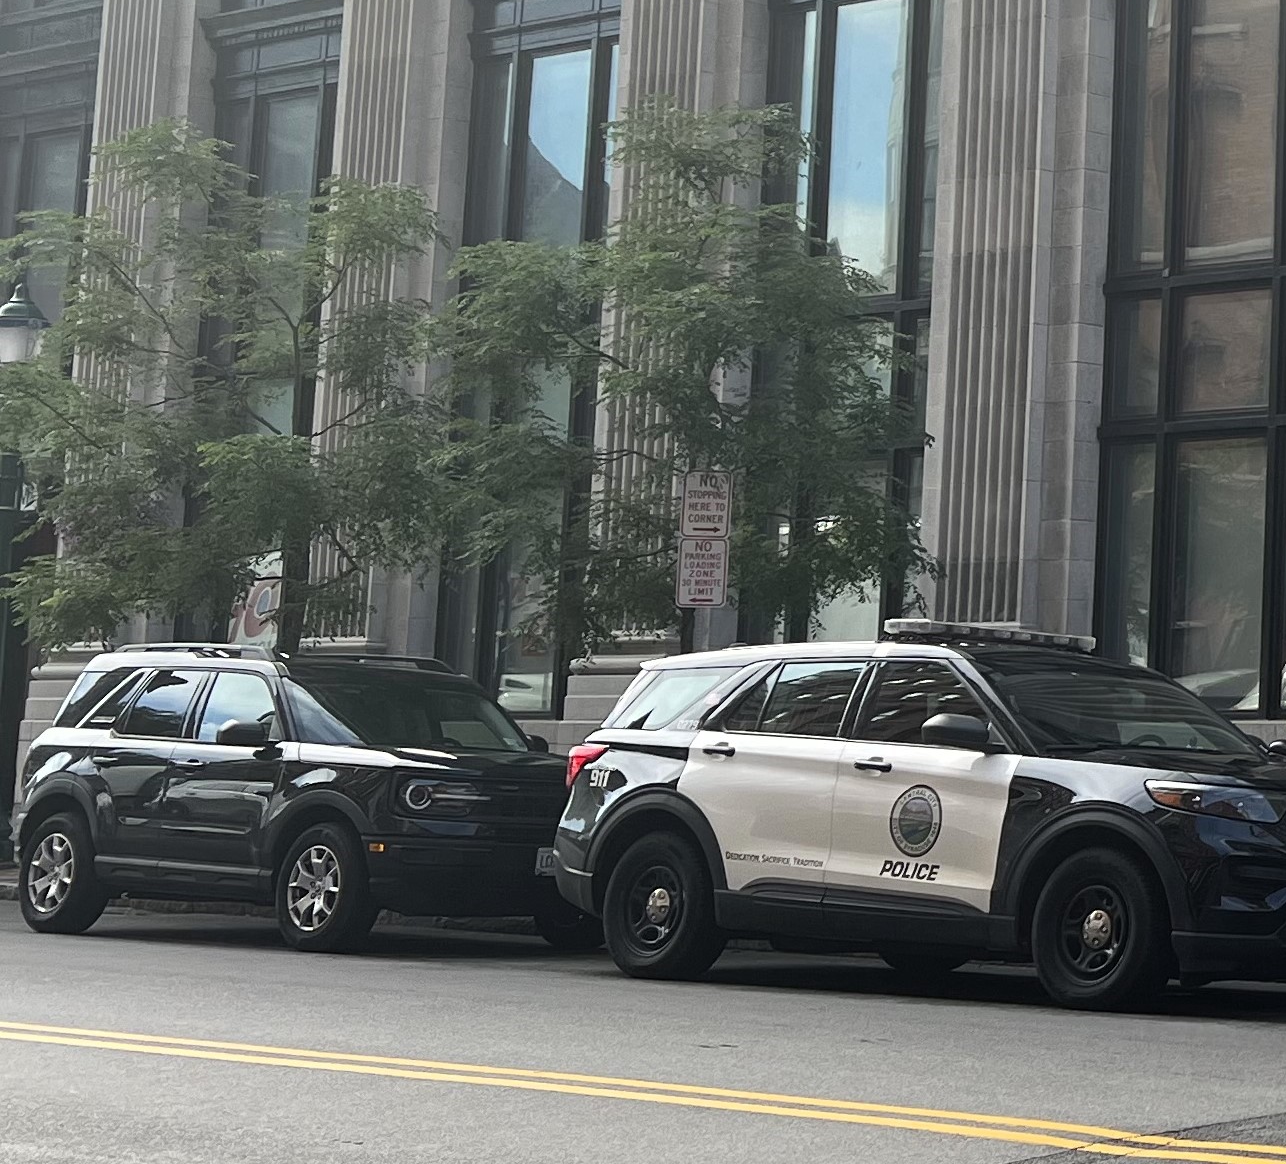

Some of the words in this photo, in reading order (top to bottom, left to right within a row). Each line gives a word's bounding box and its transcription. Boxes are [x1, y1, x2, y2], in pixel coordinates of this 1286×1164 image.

[700, 474, 718, 487] NO
[687, 490, 727, 500] STOPPING
[688, 502, 711, 511] HERE
[715, 503, 726, 512] TO
[688, 514, 724, 524] CORNER
[694, 541, 712, 552] NO
[684, 552, 722, 561] PARKING
[684, 561, 721, 570] LOADING
[689, 569, 715, 578] ZONE
[694, 578, 722, 587] MINUTE
[687, 587, 714, 596] LIMIT
[590, 769, 610, 787] 911
[879, 860, 940, 881] POLICE
